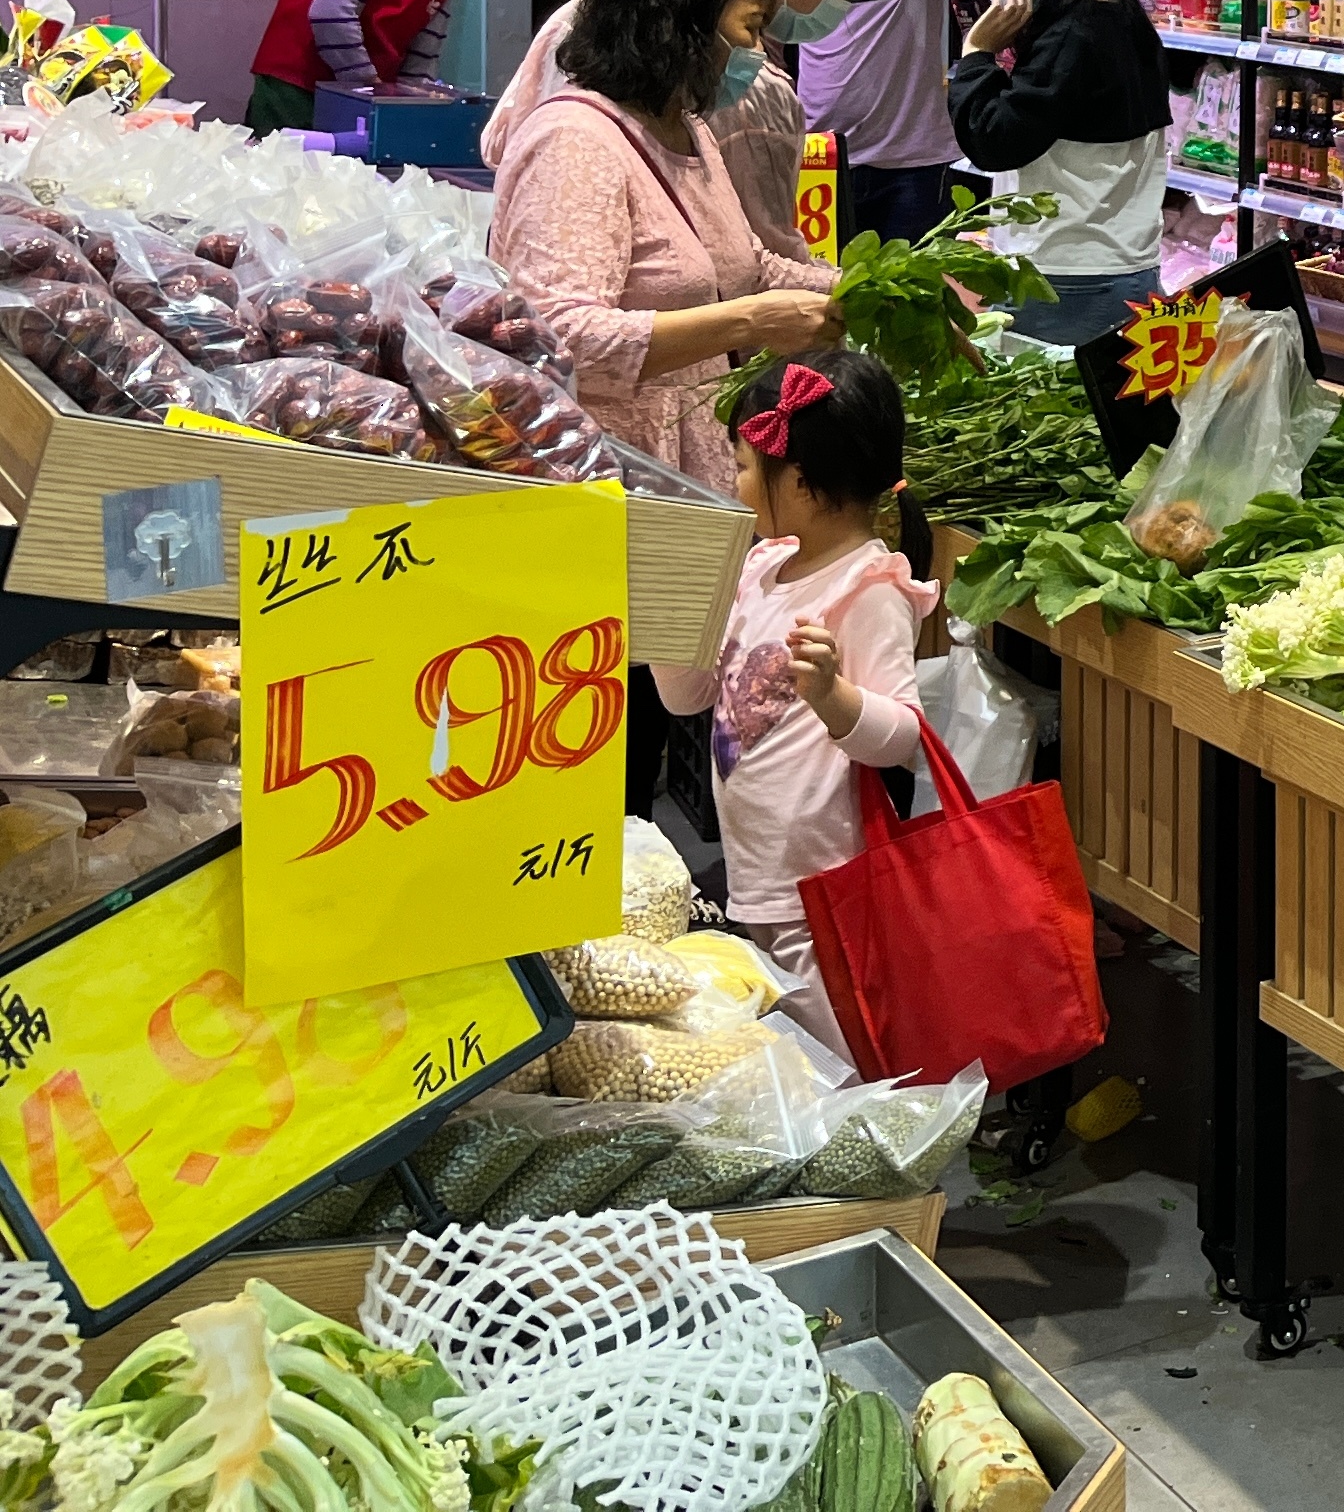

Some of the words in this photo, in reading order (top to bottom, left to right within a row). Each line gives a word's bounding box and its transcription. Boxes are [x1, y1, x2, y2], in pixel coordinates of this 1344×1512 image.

[262, 616, 625, 862] 5.98
[513, 833, 595, 886] 元/斤
[413, 1022, 487, 1100] 元/斤
